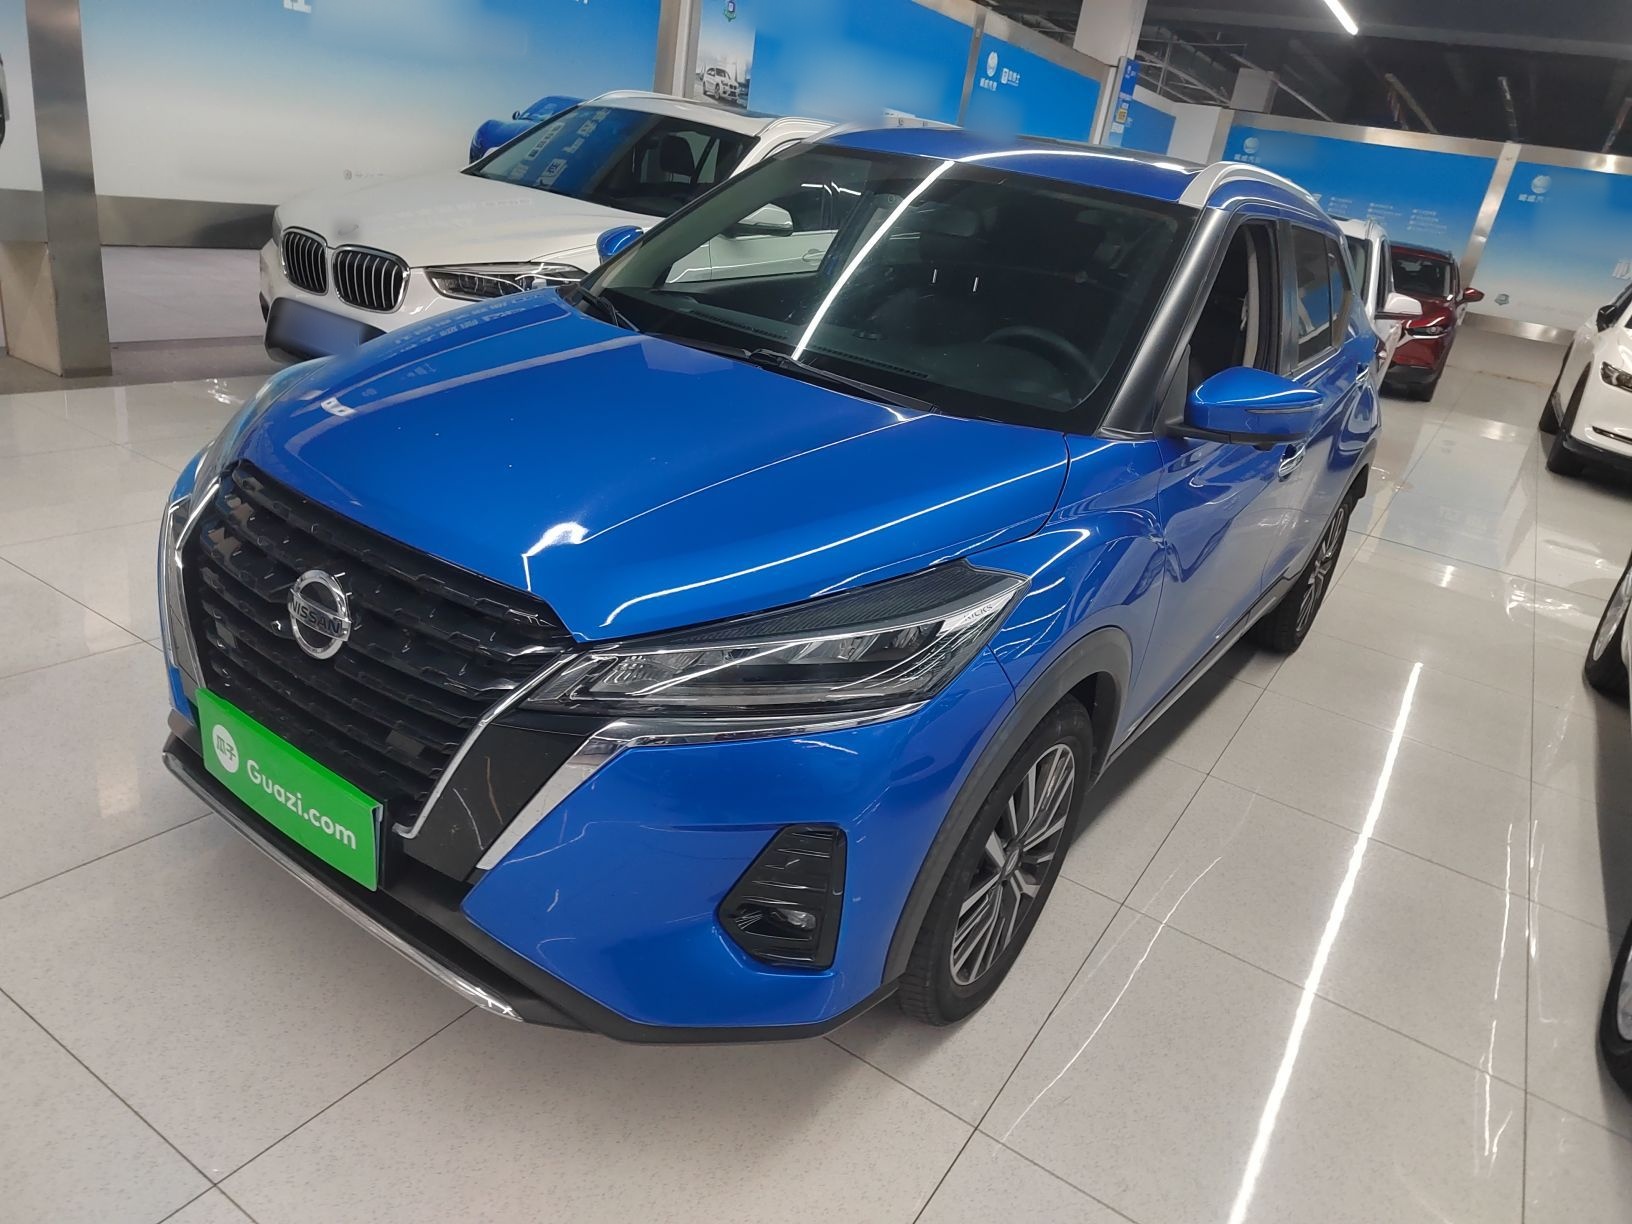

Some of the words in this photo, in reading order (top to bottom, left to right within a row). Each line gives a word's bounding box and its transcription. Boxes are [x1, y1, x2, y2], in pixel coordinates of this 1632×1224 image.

[292, 601, 341, 635] NISSAN
[216, 735, 237, 761] 瓜子
[247, 759, 356, 850] Guazi.com
